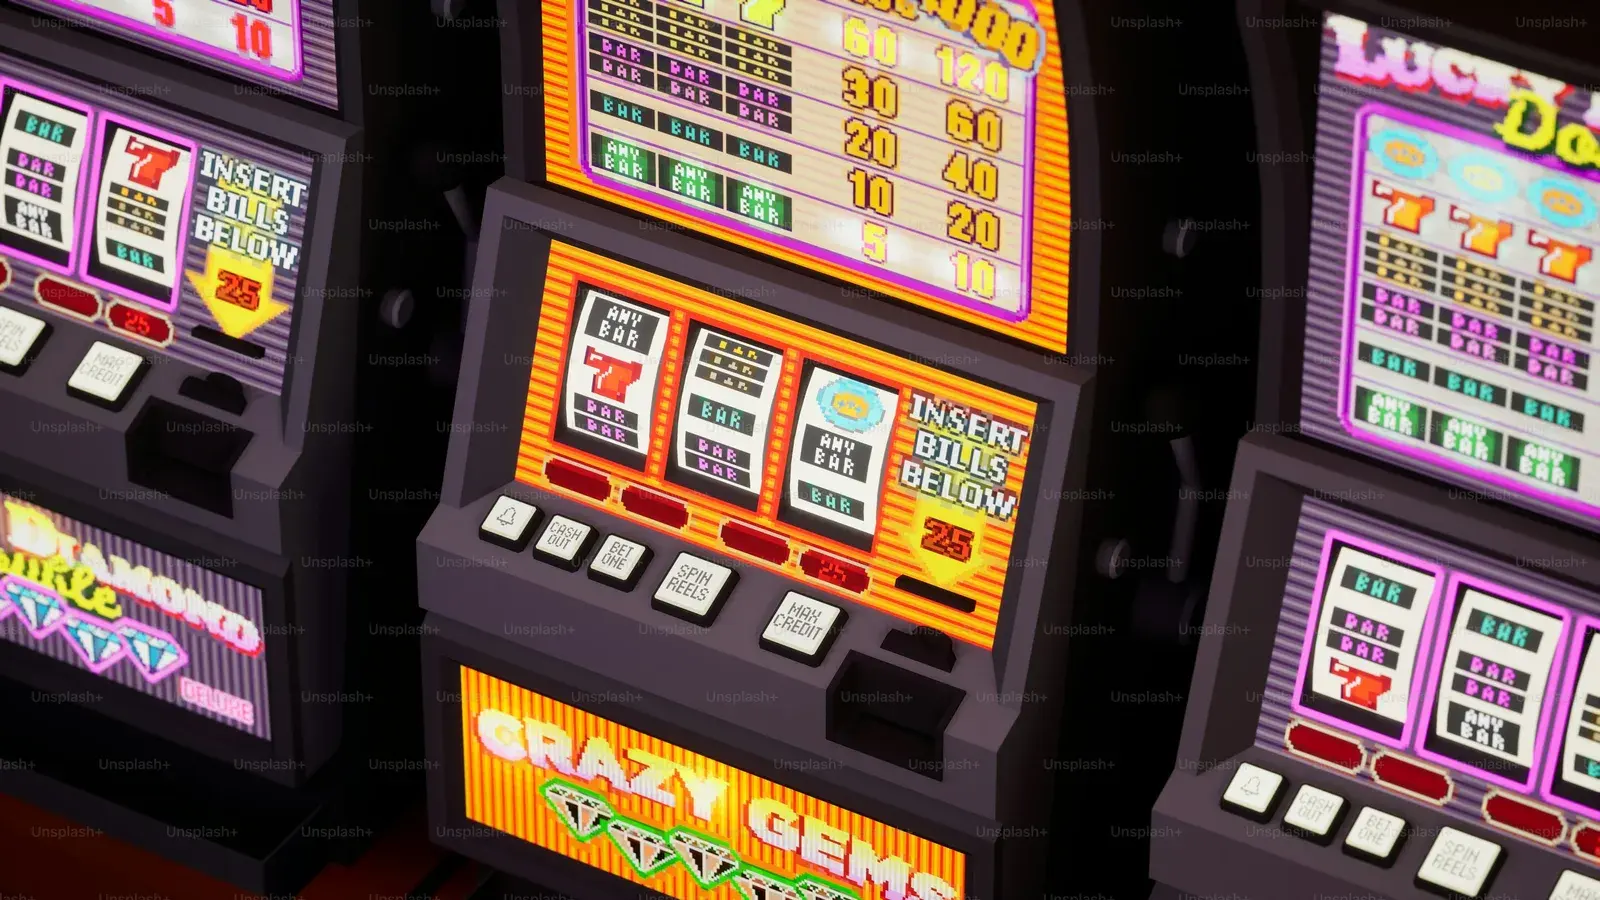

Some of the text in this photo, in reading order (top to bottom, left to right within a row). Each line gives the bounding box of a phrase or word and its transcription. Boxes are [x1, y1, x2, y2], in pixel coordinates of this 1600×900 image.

[230, 12, 272, 59] 10
[842, 15, 898, 69] 60
[934, 43, 1010, 103] 120
[842, 65, 898, 120] 30
[946, 99, 1002, 153] 60
[25, 115, 64, 143] BAR
[125, 135, 181, 190] 7
[603, 97, 998, 201] BAR BAR BAR 20 40
[200, 150, 307, 207] INSERT
[607, 140, 1000, 252] ANY ANY ANY 10 20
[17, 200, 48, 222] ANY
[207, 187, 290, 236] BILLS
[604, 153, 996, 300] BAR BAR BAR 5 10
[1372, 179, 1592, 284] 7 7 7
[116, 243, 154, 269] BAR
[194, 214, 299, 270] BELOW
[215, 267, 262, 312] 25
[125, 310, 150, 336] 25
[607, 304, 643, 328] ANY
[598, 320, 640, 348] BAR
[79, 362, 124, 387] CREDIT
[93, 352, 125, 371] MAX
[583, 345, 643, 404] 7
[1371, 348, 1571, 428] BAR BAR BAR
[702, 400, 741, 430] BAR
[909, 392, 1029, 454] INSERT
[1371, 392, 1564, 467] ANY ANY ANY
[820, 433, 855, 456] ANY
[914, 428, 1009, 484] BILLS
[1367, 405, 1566, 487] BAR BAR BAR
[814, 447, 854, 476] BAR
[811, 487, 851, 514] BAR
[900, 458, 1017, 521] BELOW
[547, 534, 572, 551] OUT
[549, 520, 583, 541] CASH
[921, 515, 975, 563] 25
[601, 552, 628, 571] ONE
[608, 540, 634, 558] BET
[677, 563, 713, 587] SPIN
[818, 558, 848, 583] 25
[665, 576, 710, 602] REELS
[1355, 572, 1401, 604] BAR
[787, 601, 823, 623] MAX
[773, 613, 824, 641] CREDIT
[1480, 614, 1529, 647] BAR
[1329, 657, 1392, 711] 7
[1460, 720, 1505, 750] BAR
[1464, 709, 1504, 733] ANY
[474, 708, 729, 822] CRAZY
[1297, 806, 1324, 824] OUT
[1299, 792, 1335, 815] CASH
[1358, 827, 1388, 847] ONE
[1366, 813, 1393, 833] BET
[1441, 838, 1481, 864] SPIN
[1431, 853, 1478, 881] REELS
